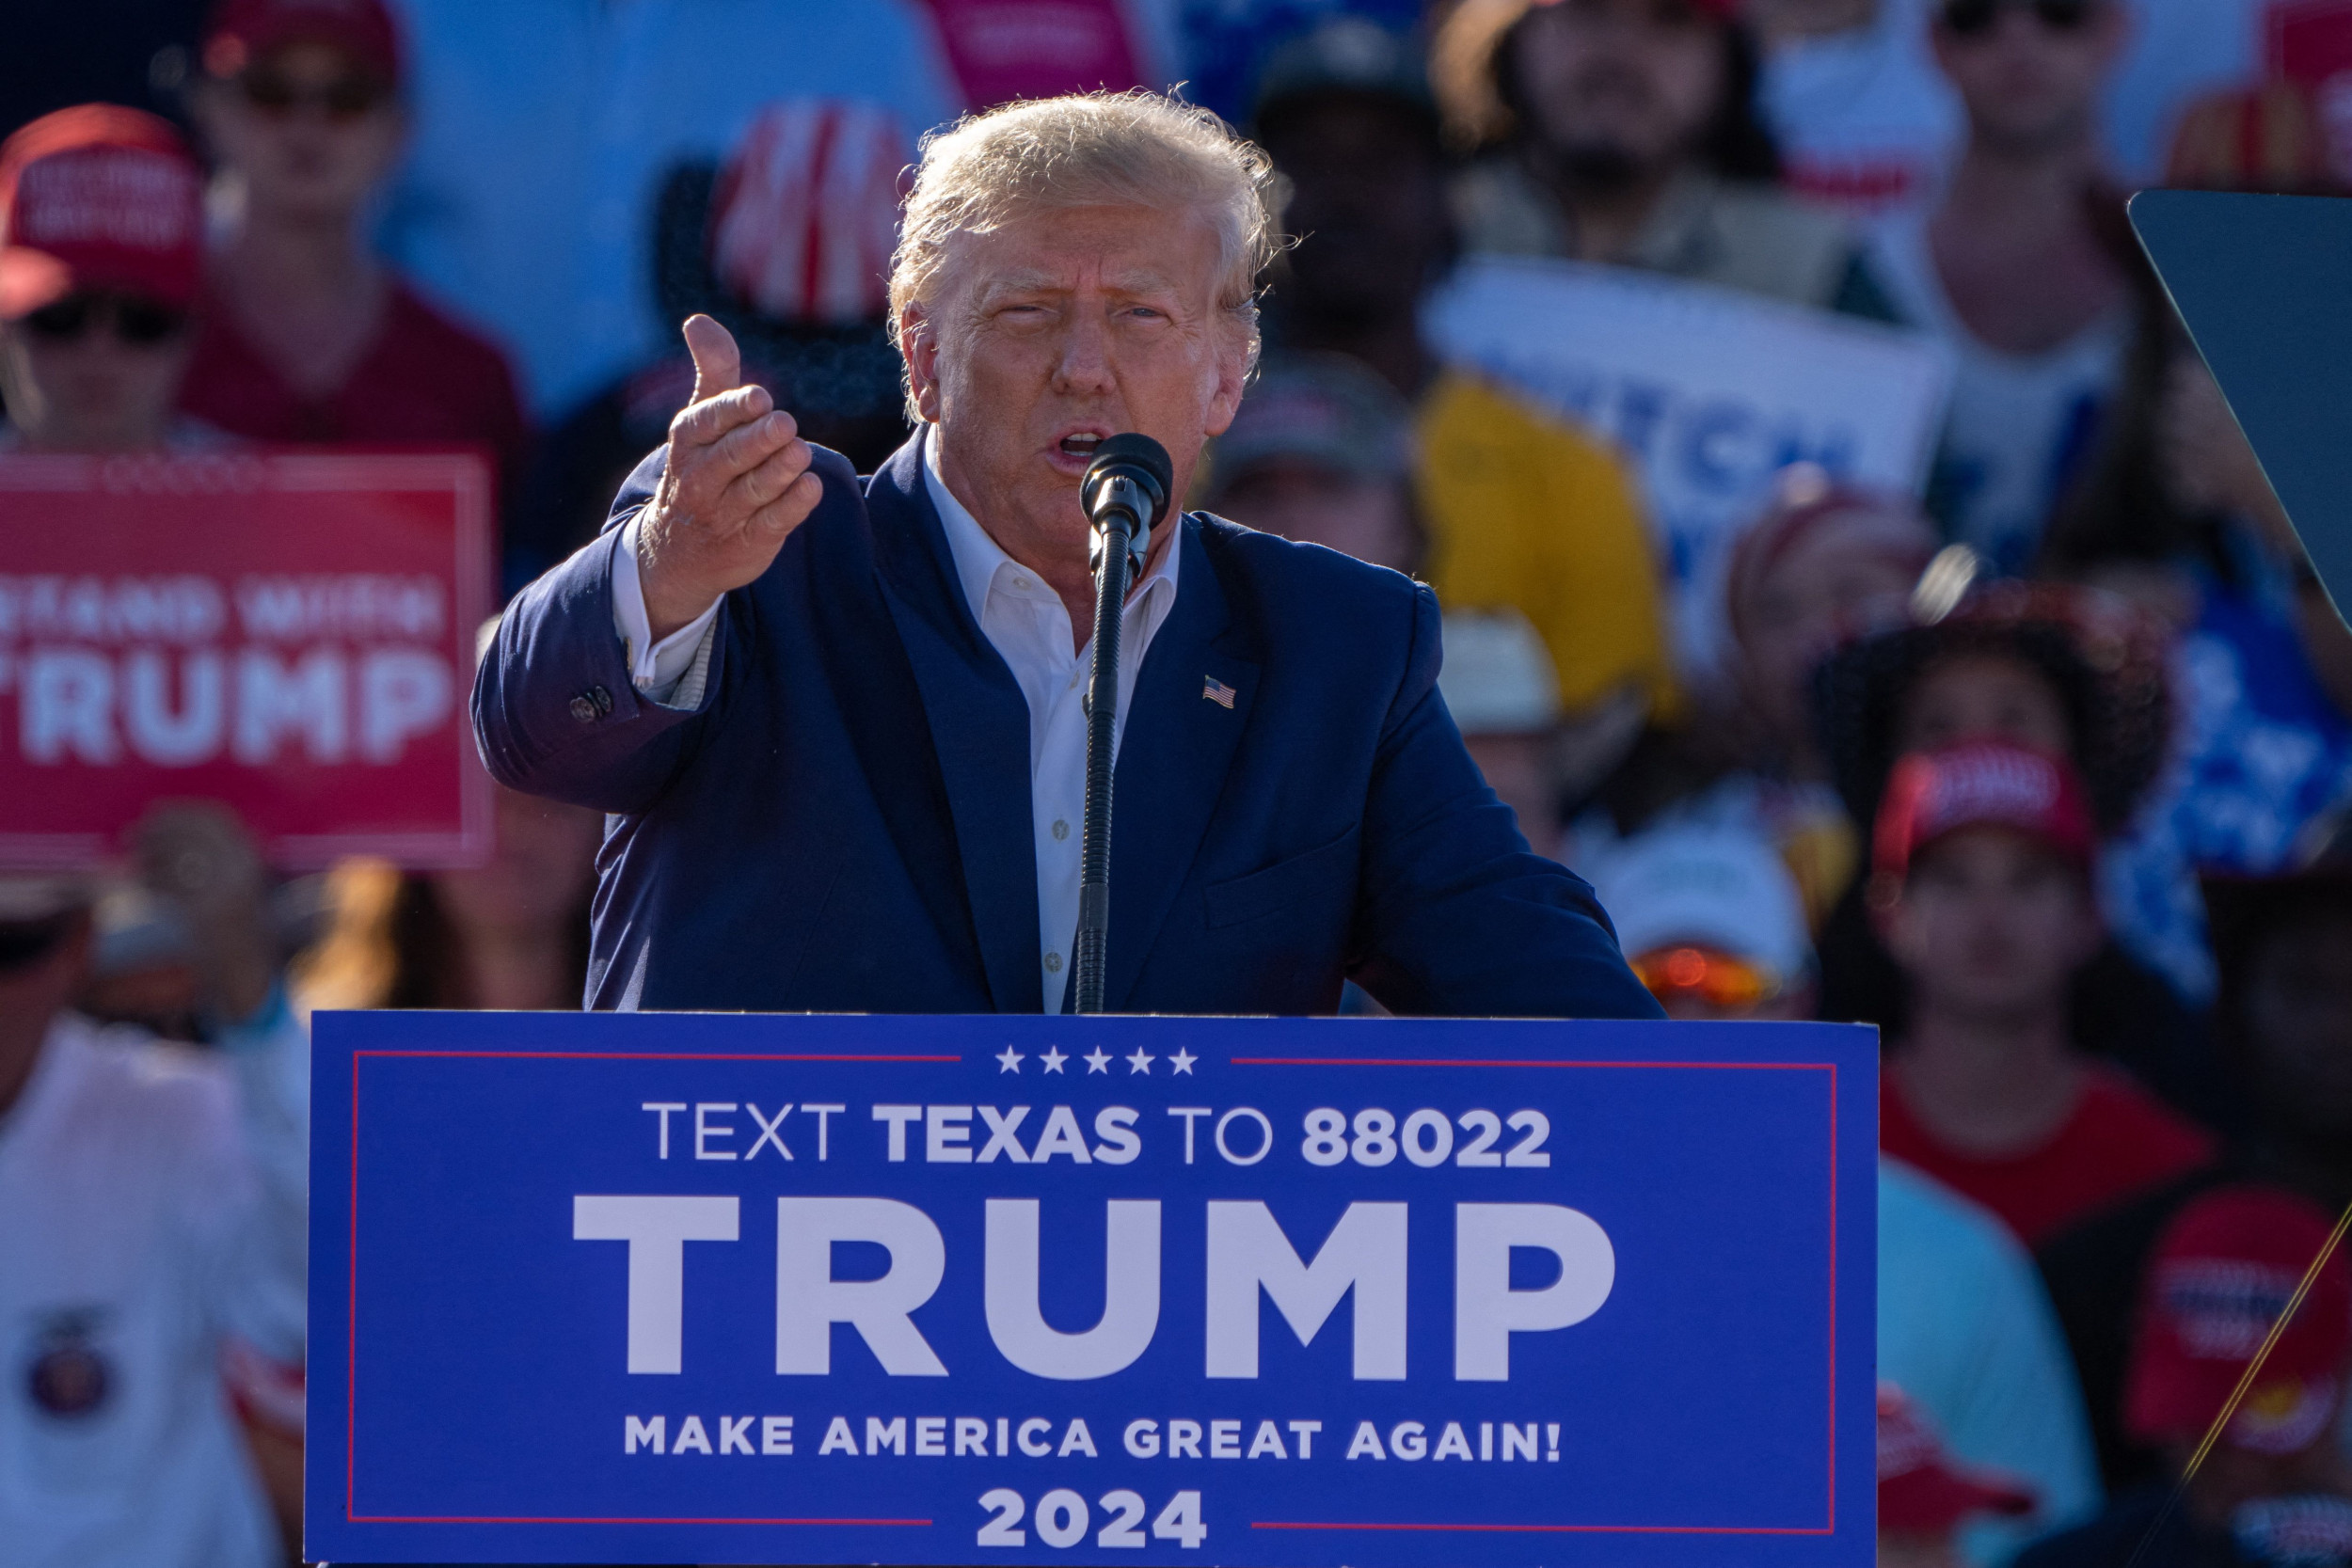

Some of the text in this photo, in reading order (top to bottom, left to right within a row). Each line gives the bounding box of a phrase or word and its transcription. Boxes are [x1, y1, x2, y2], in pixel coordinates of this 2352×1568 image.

[234, 575, 446, 642] WITH
[0, 646, 453, 768] RUMP
[642, 1102, 1551, 1167] TEXT TEXAS TO 88022
[573, 1195, 1615, 1382] TRUMP
[625, 1415, 1561, 1462] MAKE AMERICA GREAT AGAIN!
[977, 1488, 1207, 1548] 2024
